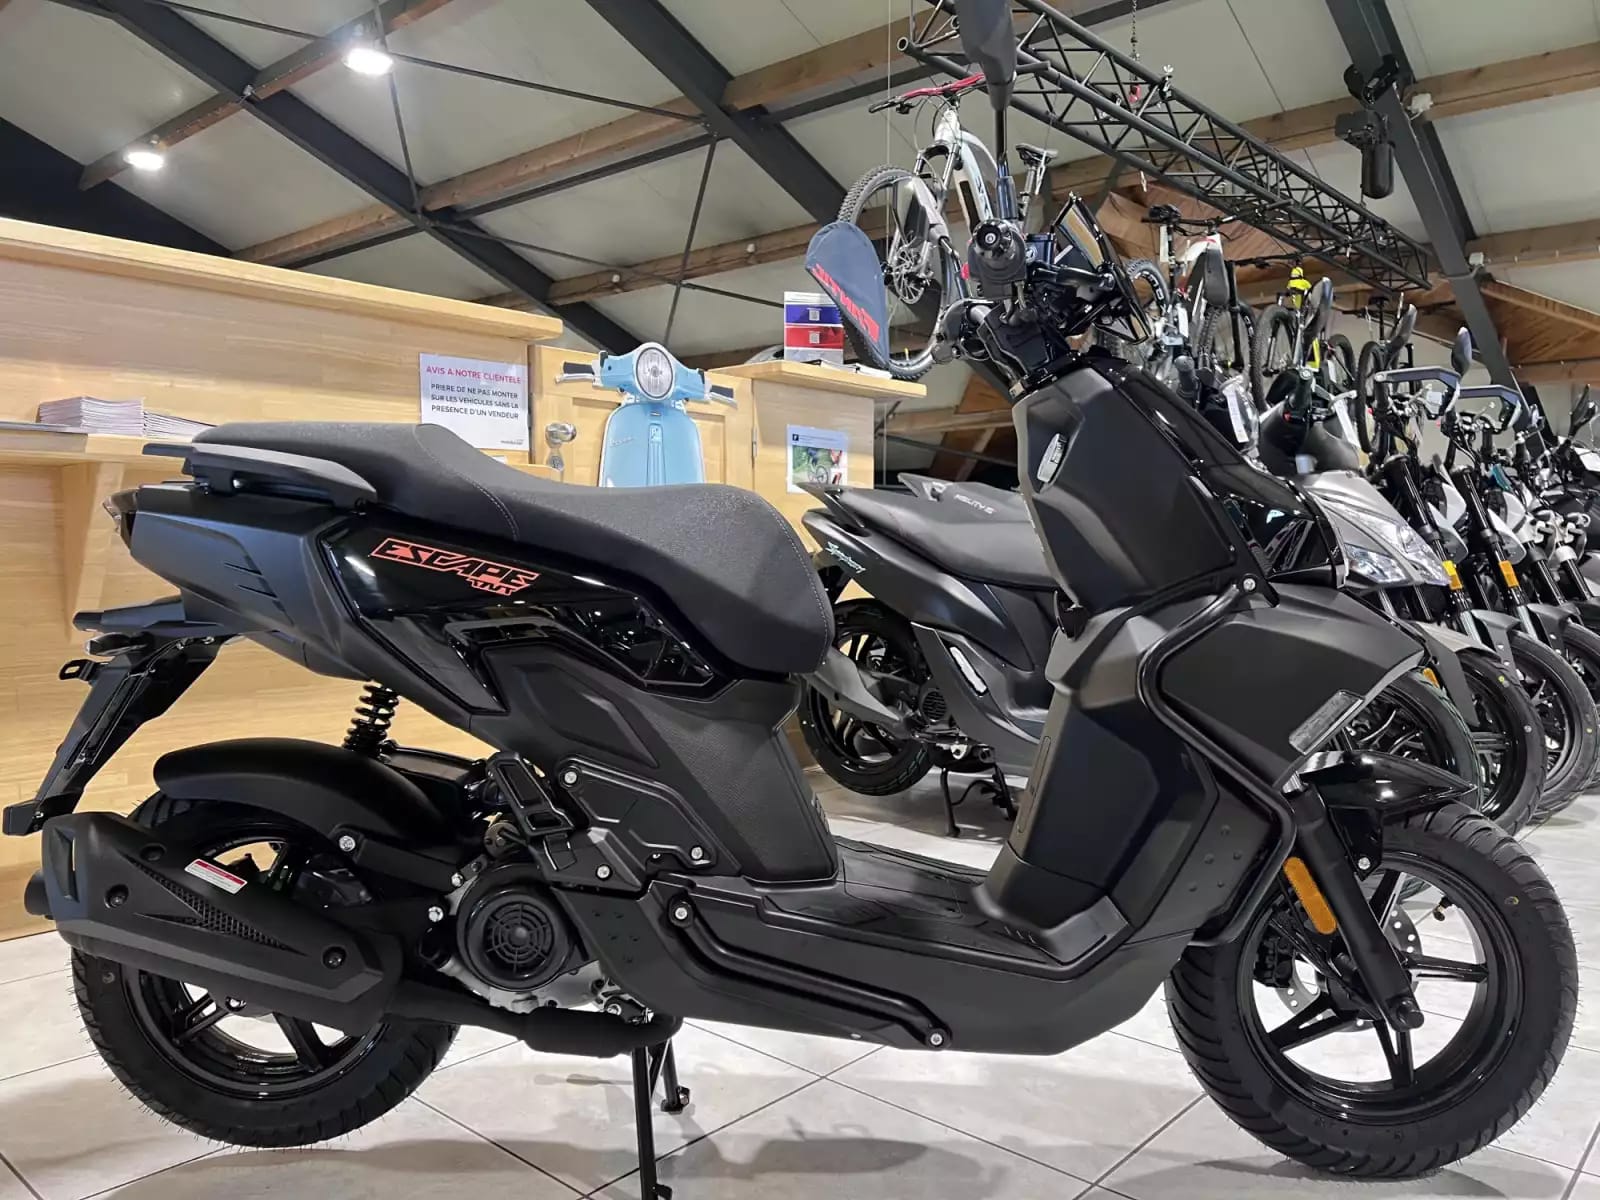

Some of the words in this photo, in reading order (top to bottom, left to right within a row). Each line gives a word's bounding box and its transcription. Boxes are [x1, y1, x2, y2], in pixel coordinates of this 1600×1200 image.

[426, 365, 445, 375] AVIS
[447, 368, 454, 376] A
[455, 368, 482, 379] NOTRE
[483, 373, 521, 384] CLIENTELE
[431, 383, 455, 393] PRIERE
[467, 387, 476, 395] NE
[477, 388, 490, 396] PAS
[492, 390, 518, 399] MONTER
[458, 397, 493, 407] VEHICULES
[494, 400, 510, 408] SANS
[431, 405, 468, 415] PRESENCE
[469, 408, 487, 417] D'UN
[488, 411, 519, 420] VENDEUR
[370, 537, 541, 589] ESCAPE
